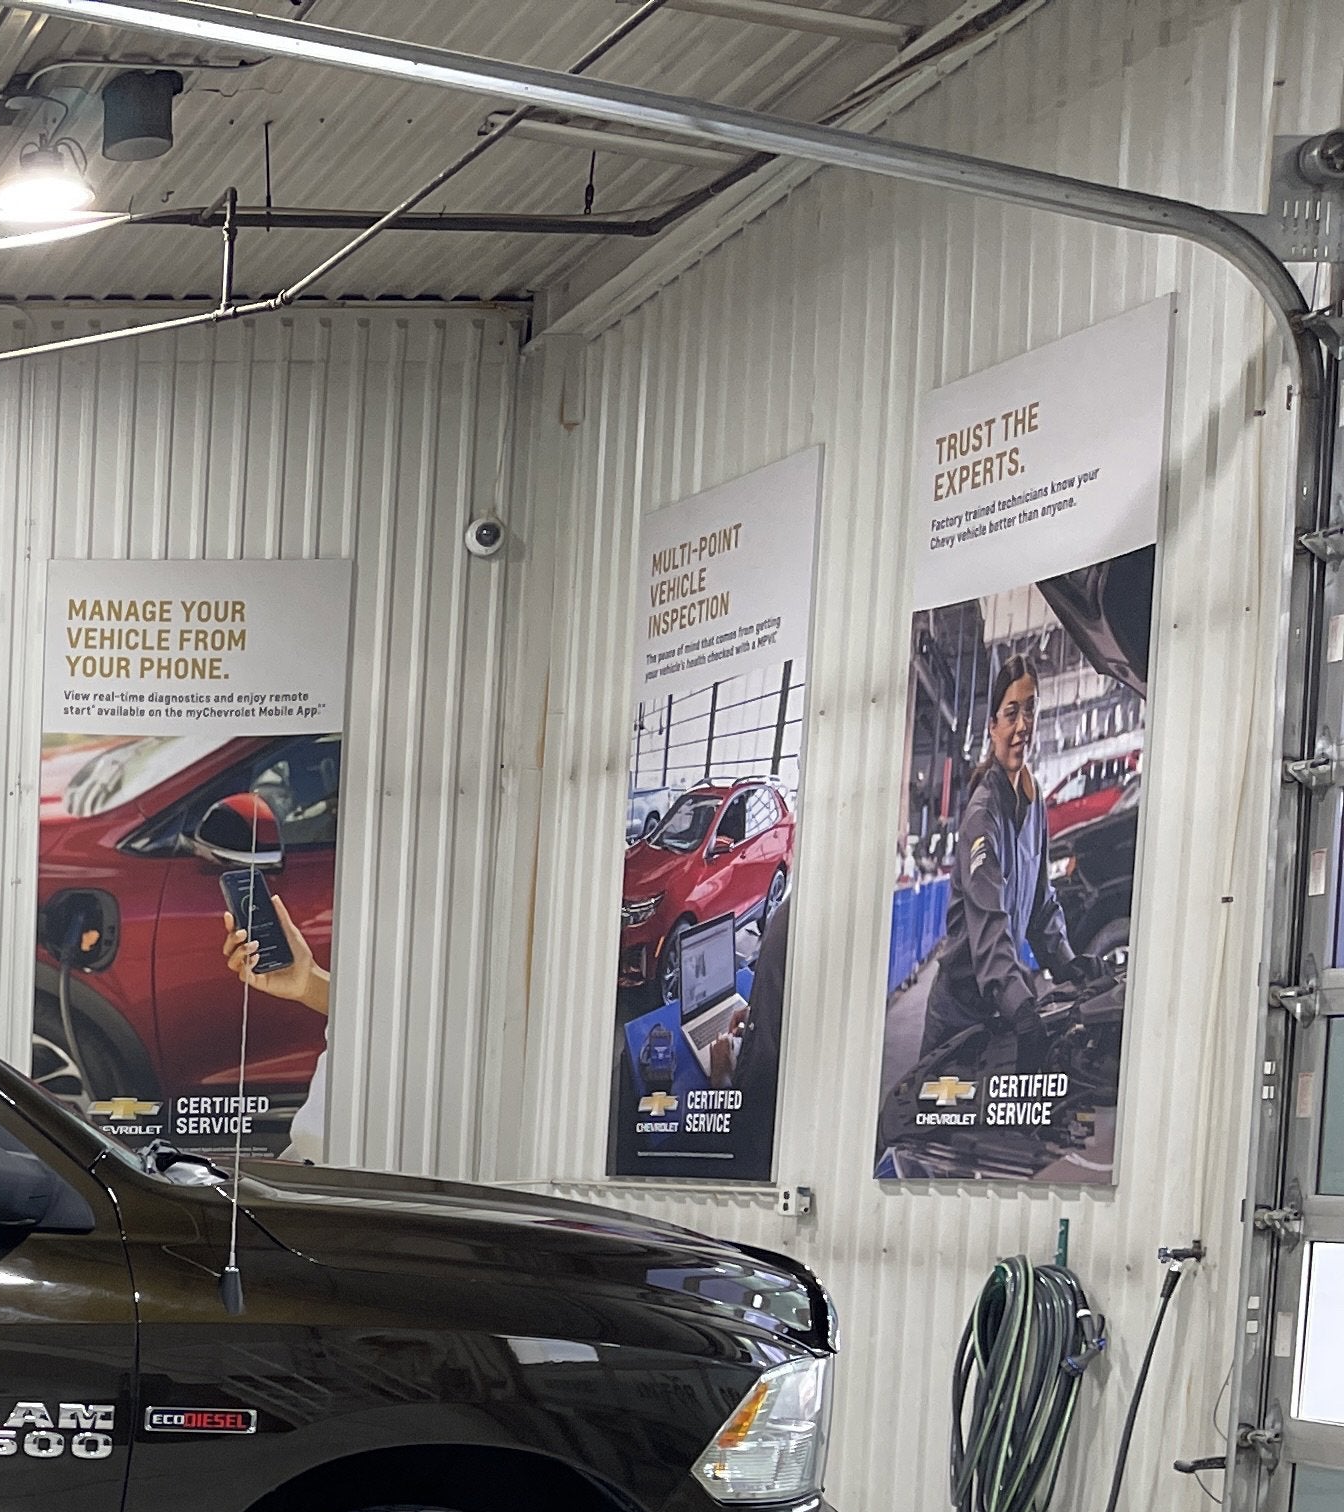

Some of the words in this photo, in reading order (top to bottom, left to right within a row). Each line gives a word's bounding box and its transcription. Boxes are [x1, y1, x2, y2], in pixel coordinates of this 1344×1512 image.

[936, 418, 995, 464] TRUST
[1001, 402, 1040, 441] THE
[934, 447, 1024, 501] EXPERTS.
[931, 515, 963, 532] Factory
[965, 501, 995, 521] trained
[998, 486, 1048, 512] technicians
[1051, 477, 1075, 494] know
[1077, 468, 1101, 488] your
[930, 534, 954, 550] Chevy
[957, 524, 986, 541] vehicle
[989, 516, 1016, 533] better
[1019, 508, 1038, 524] than
[1041, 498, 1076, 517] anyone.
[652, 523, 742, 577] MULTI-POINT
[651, 568, 706, 607] VEHICLE
[68, 599, 172, 622] MANAGE
[180, 601, 245, 623] YOUR
[648, 591, 729, 639] INSPECTION
[67, 628, 170, 650] VEHICLE
[179, 629, 246, 651] FROM
[65, 656, 131, 678] YOUR
[139, 657, 229, 679] PHONE.
[64, 690, 90, 701] View
[93, 691, 145, 702] real-time
[148, 691, 210, 704] diagnostics
[214, 692, 234, 703] and
[237, 692, 266, 705] enjoy
[269, 692, 309, 702] remote
[98, 706, 145, 716] available
[149, 707, 162, 717] on
[165, 707, 182, 718] the
[186, 707, 255, 720] myChevrolet
[259, 706, 293, 717] Mobile
[989, 1074, 1068, 1098] CERTIFIED
[177, 1096, 269, 1114] CERTIFIED
[687, 1091, 742, 1109] CERTIFIED
[685, 1114, 731, 1132] SERVICE
[916, 1114, 976, 1125] CHEVROLET
[986, 1102, 1052, 1125] SERVICE
[176, 1117, 252, 1134] SERVICE
[636, 1123, 678, 1132] CHEVROLET
[152, 1412, 247, 1429] ECODIESEL
